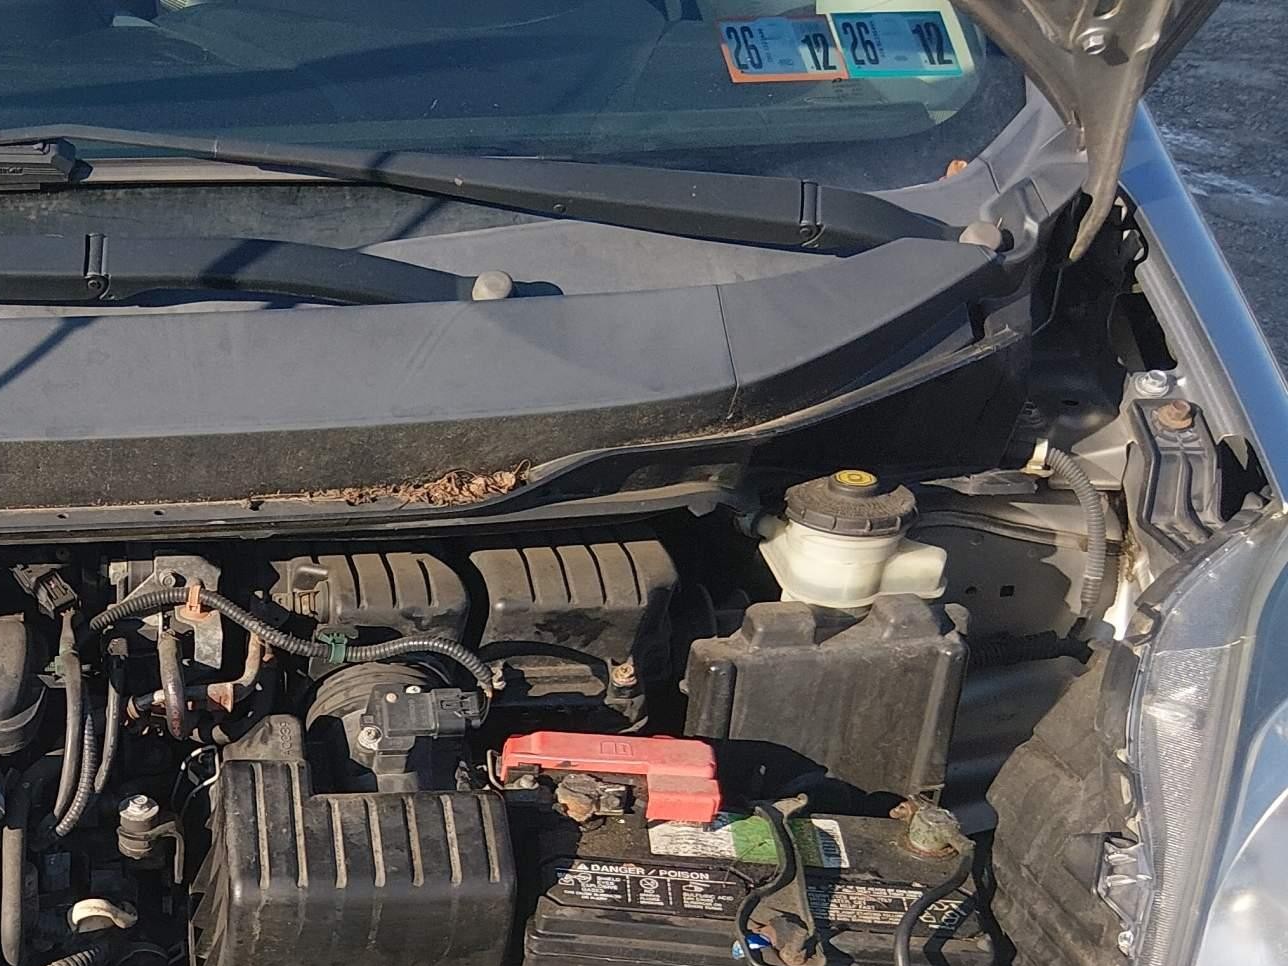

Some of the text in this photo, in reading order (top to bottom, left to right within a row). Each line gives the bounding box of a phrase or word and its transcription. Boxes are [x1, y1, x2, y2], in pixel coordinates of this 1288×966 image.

[725, 25, 763, 70] 26
[801, 32, 837, 71] 12
[841, 21, 880, 65] 26
[911, 21, 954, 65] 12
[590, 863, 645, 876] DANGER
[659, 869, 710, 881] POISON
